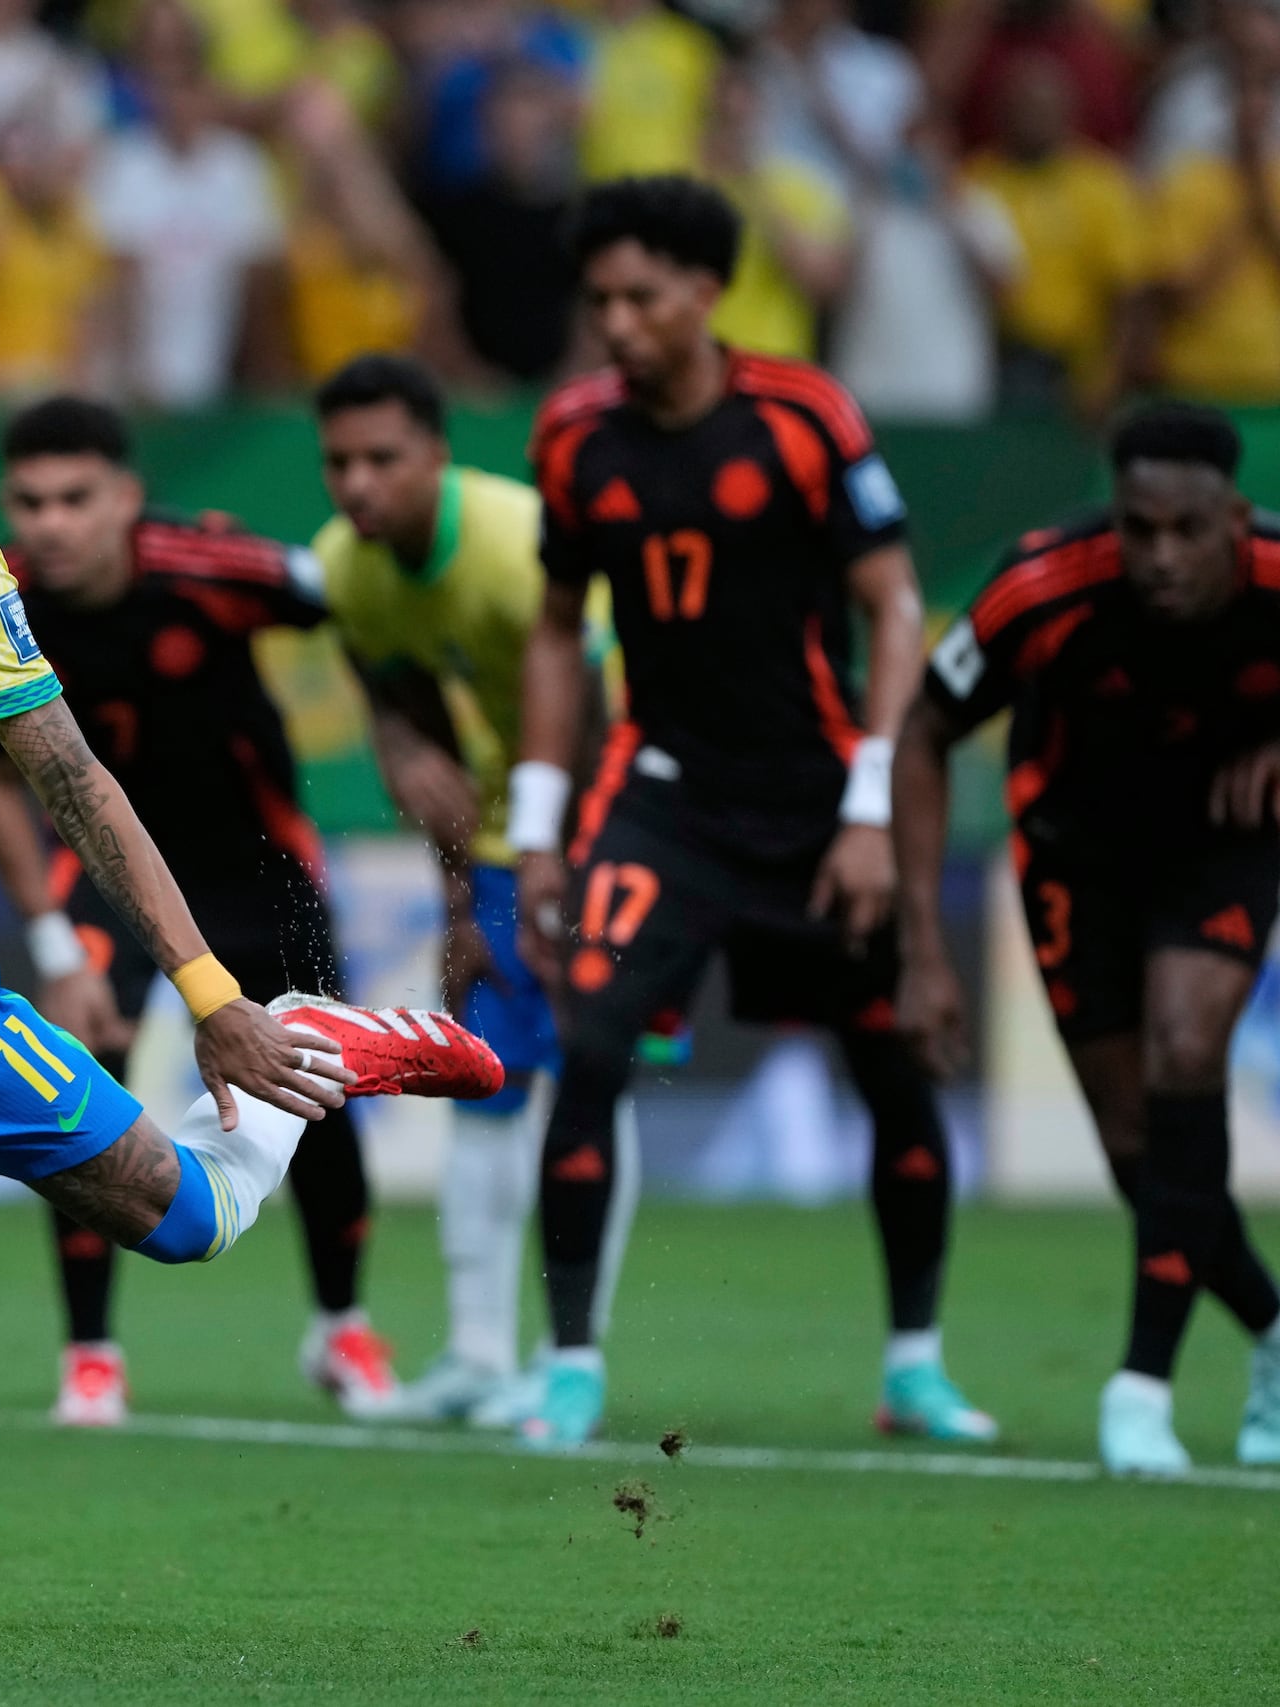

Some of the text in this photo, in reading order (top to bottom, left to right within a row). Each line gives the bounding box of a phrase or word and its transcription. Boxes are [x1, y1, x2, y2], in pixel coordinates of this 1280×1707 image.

[642, 528, 712, 623] 17
[581, 861, 661, 946] 17
[1035, 880, 1072, 968] 3
